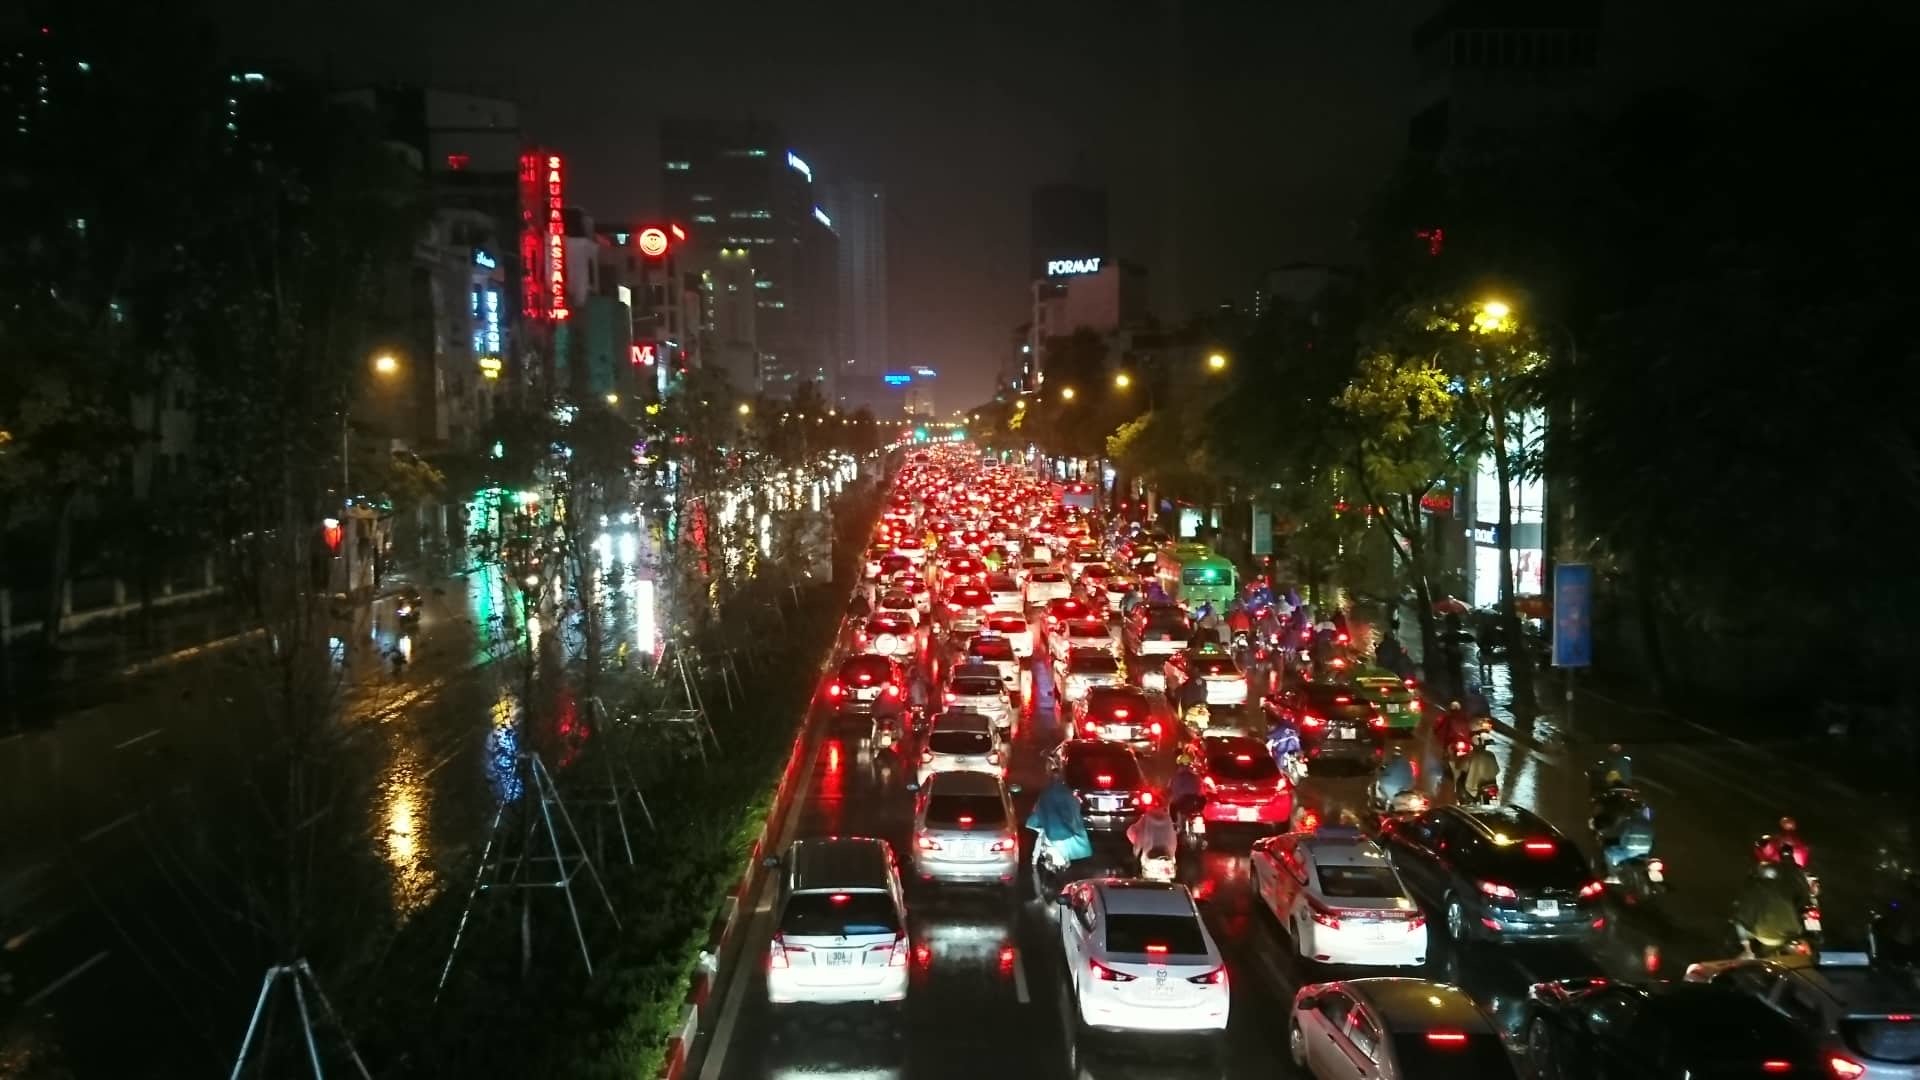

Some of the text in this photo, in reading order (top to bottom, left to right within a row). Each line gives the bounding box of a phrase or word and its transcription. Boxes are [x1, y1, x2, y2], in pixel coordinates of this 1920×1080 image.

[548, 156, 562, 221] SAUNA
[549, 222, 564, 308] MASSAGE
[1048, 257, 1101, 275] FORMAT
